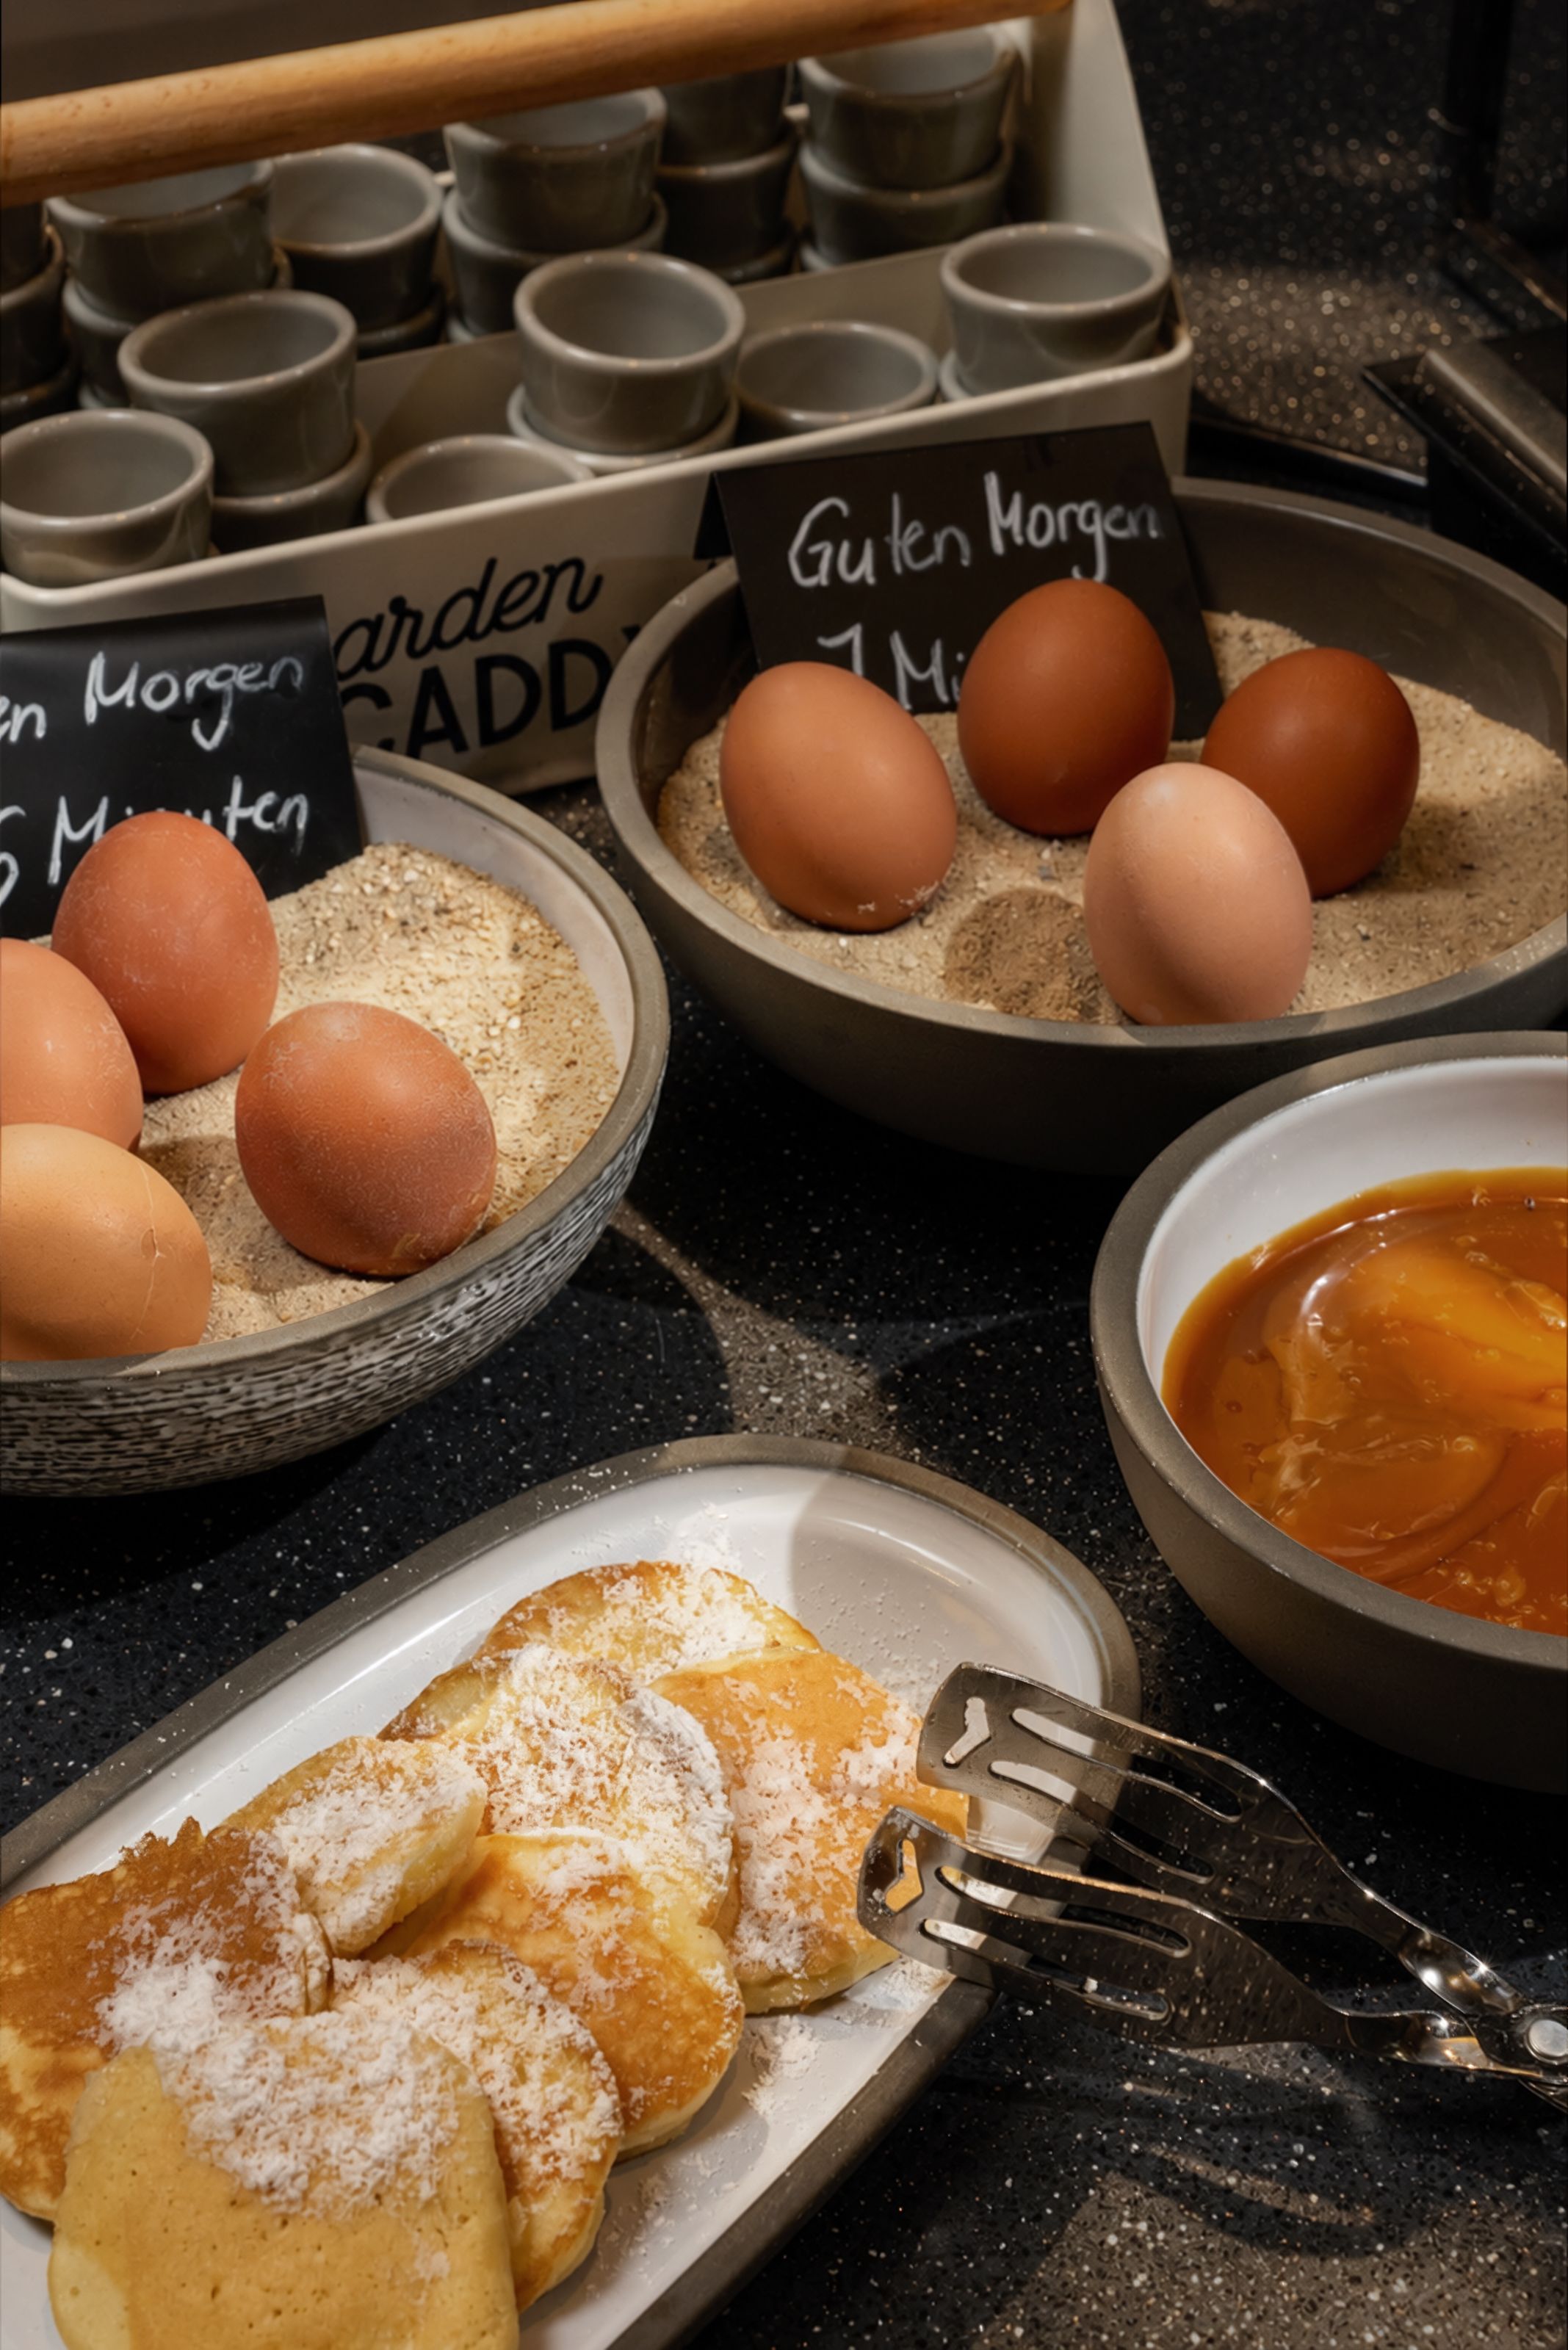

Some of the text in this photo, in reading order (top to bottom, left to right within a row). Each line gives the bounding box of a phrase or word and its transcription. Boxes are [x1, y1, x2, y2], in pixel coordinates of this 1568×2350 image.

[787, 470, 1160, 588] Guten Morgen
[85, 651, 303, 751] Morgen
